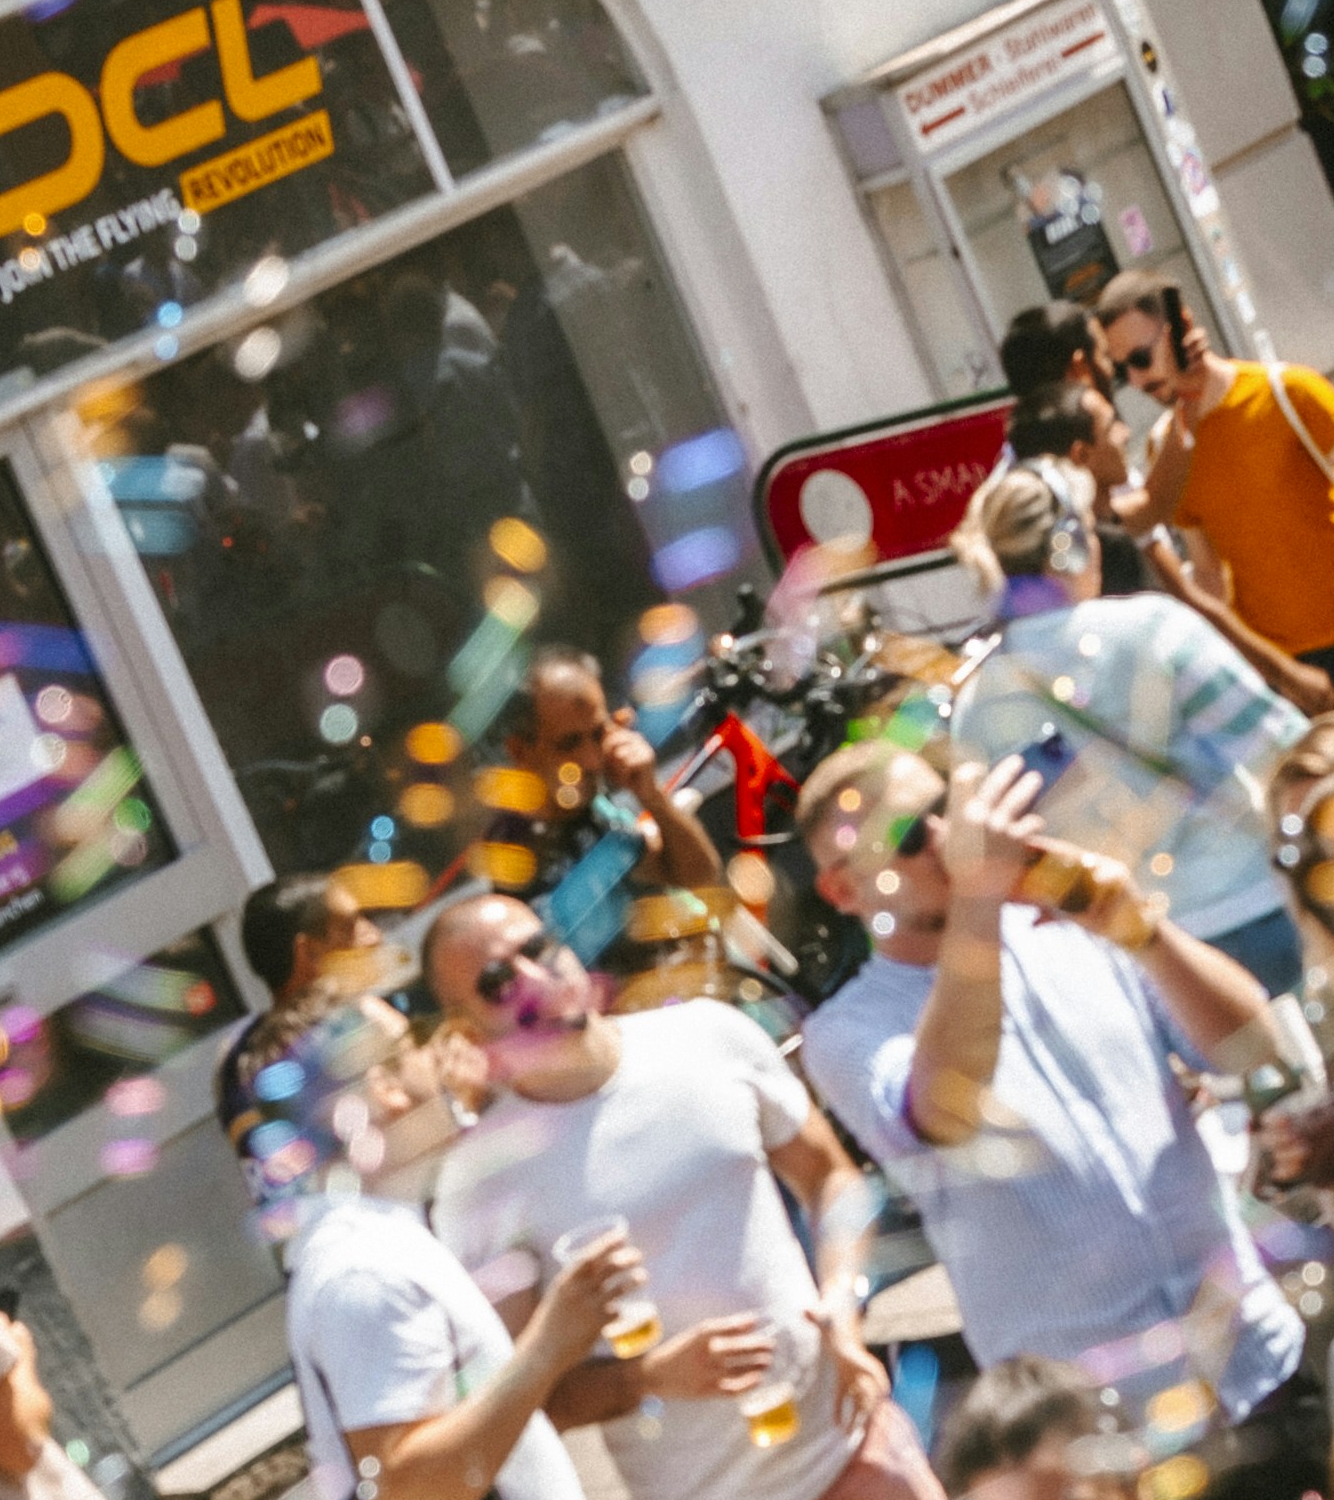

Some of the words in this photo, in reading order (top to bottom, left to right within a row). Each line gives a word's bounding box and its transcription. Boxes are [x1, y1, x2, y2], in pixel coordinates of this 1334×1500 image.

[47, 224, 103, 272] THE
[95, 187, 182, 251] FLYING
[189, 122, 326, 202] REVOLUTION
